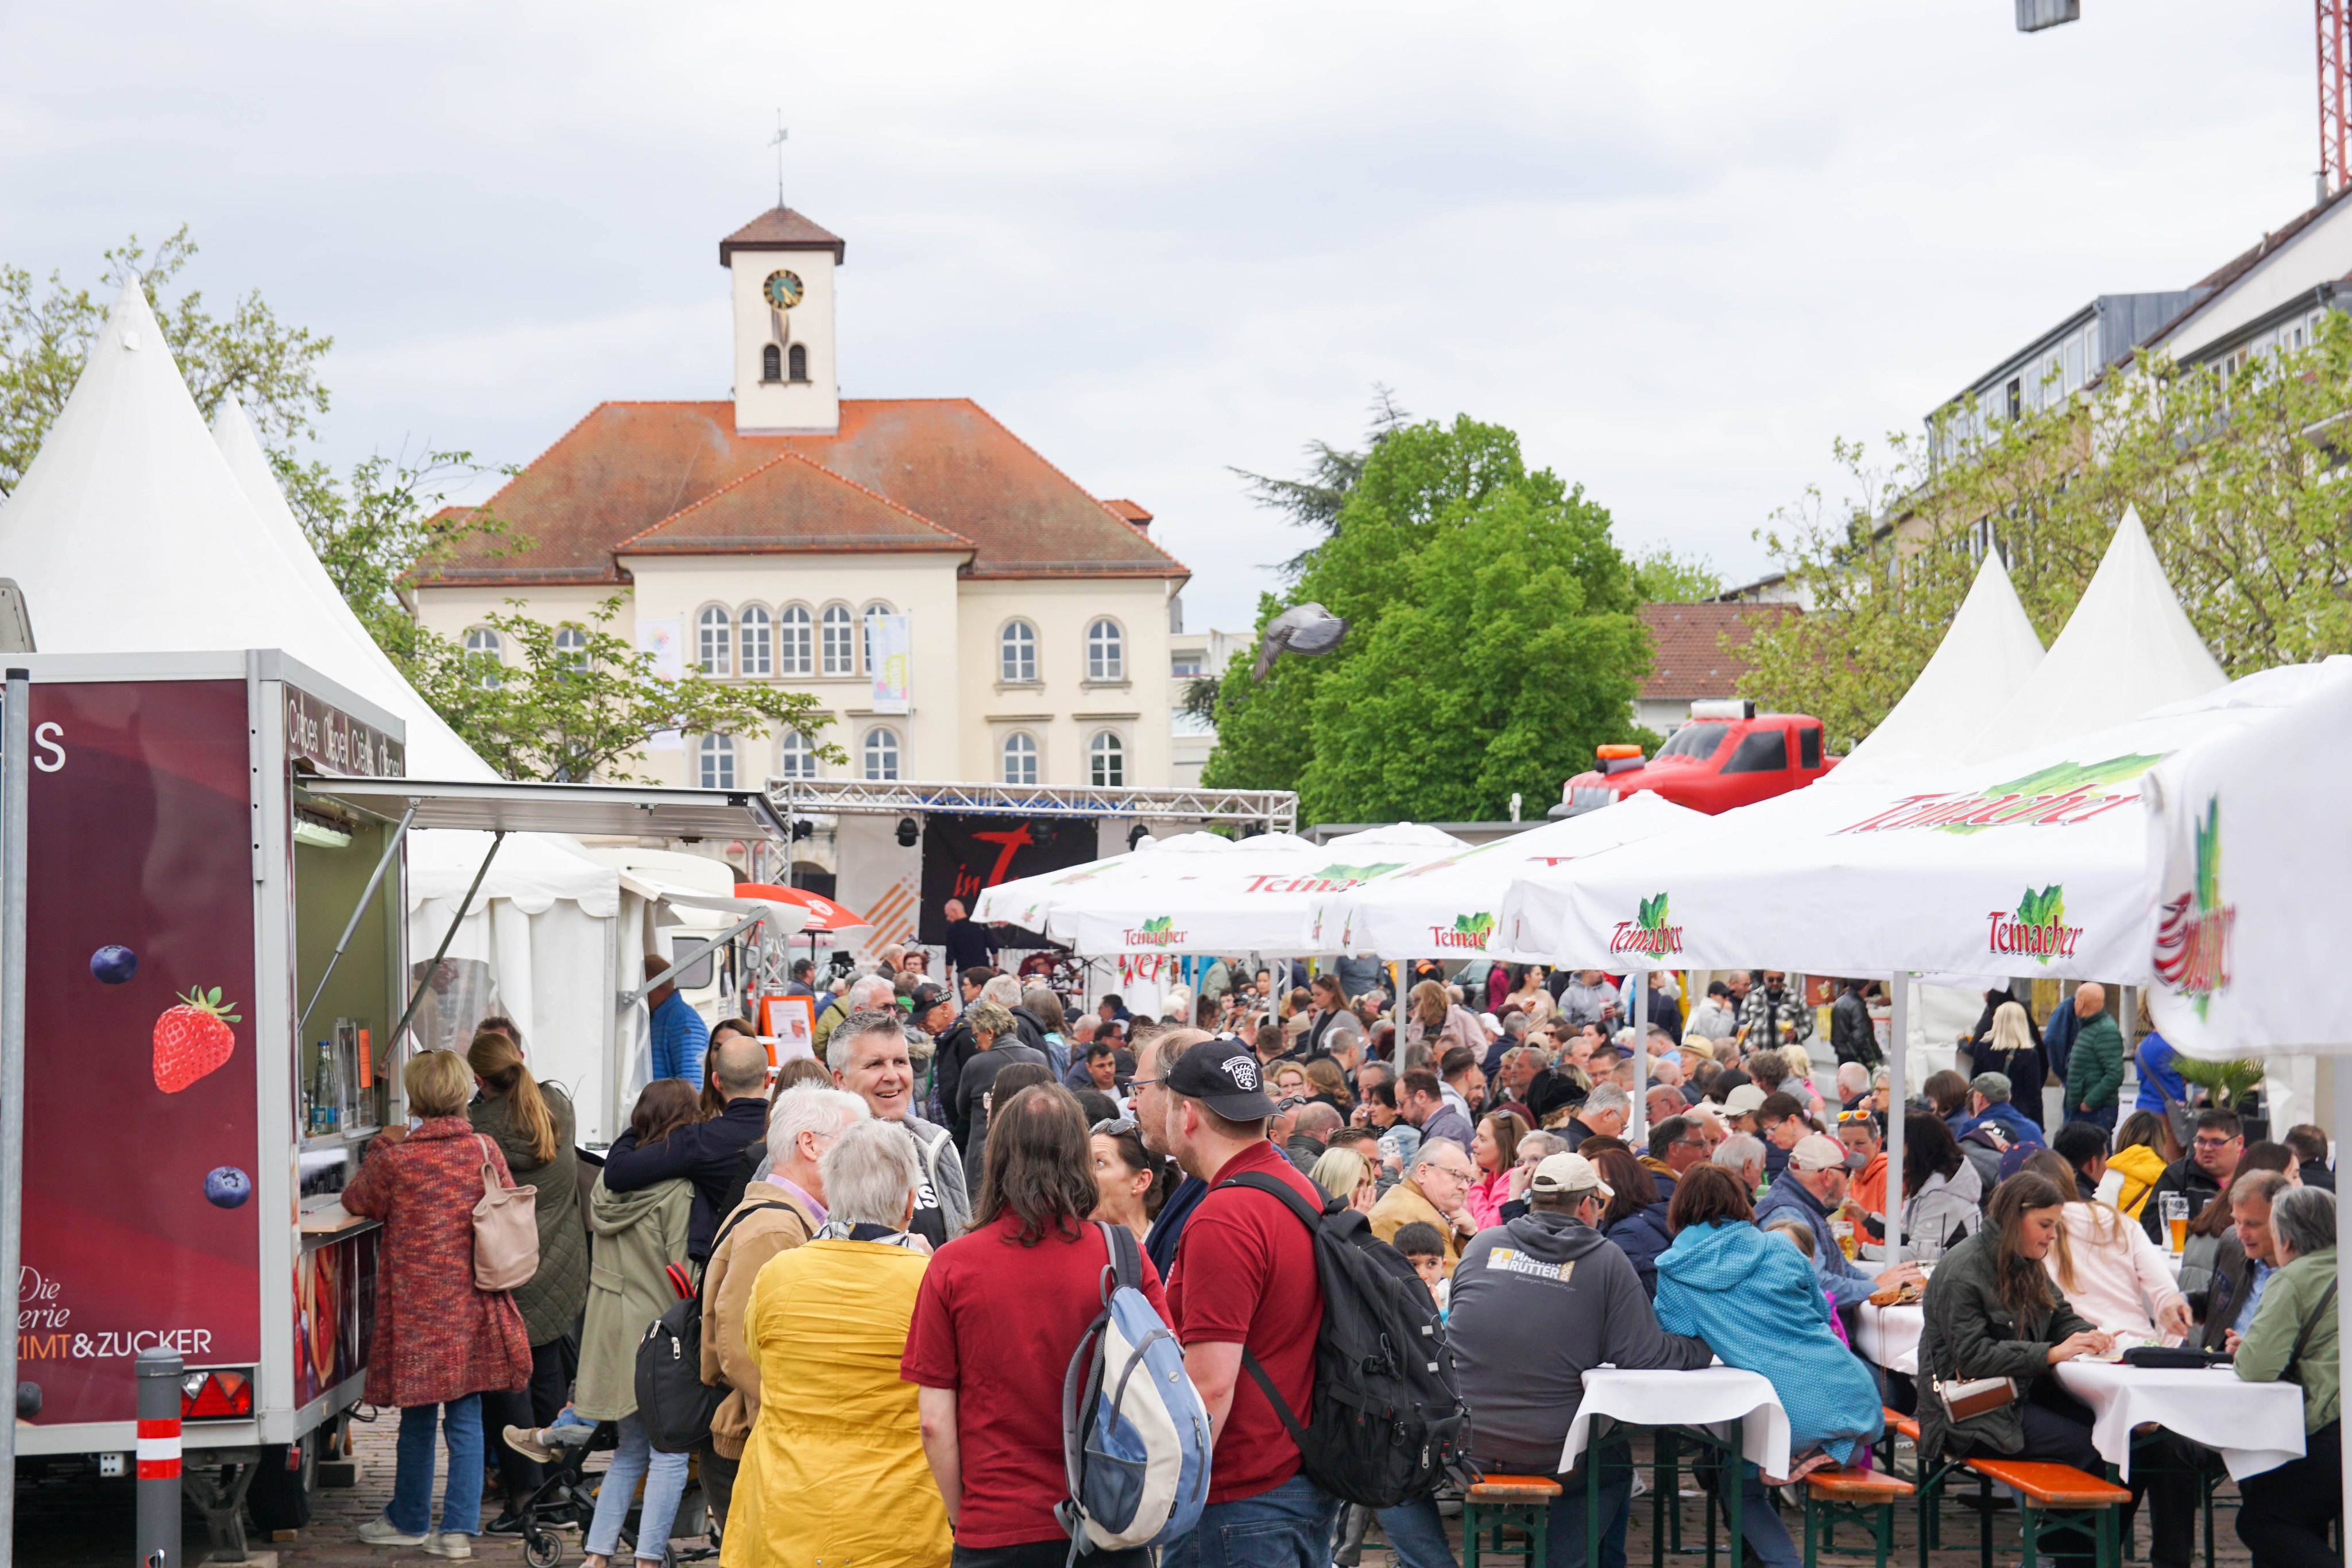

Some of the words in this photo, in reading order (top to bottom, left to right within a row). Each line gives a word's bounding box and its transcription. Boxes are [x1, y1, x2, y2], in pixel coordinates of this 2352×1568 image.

[1239, 874, 1360, 892] Teina
[1123, 927, 1188, 946] Teinacher
[1610, 917, 1683, 954] Teinacher
[1987, 911, 2084, 959] Teinacher
[18, 1265, 60, 1303] Die
